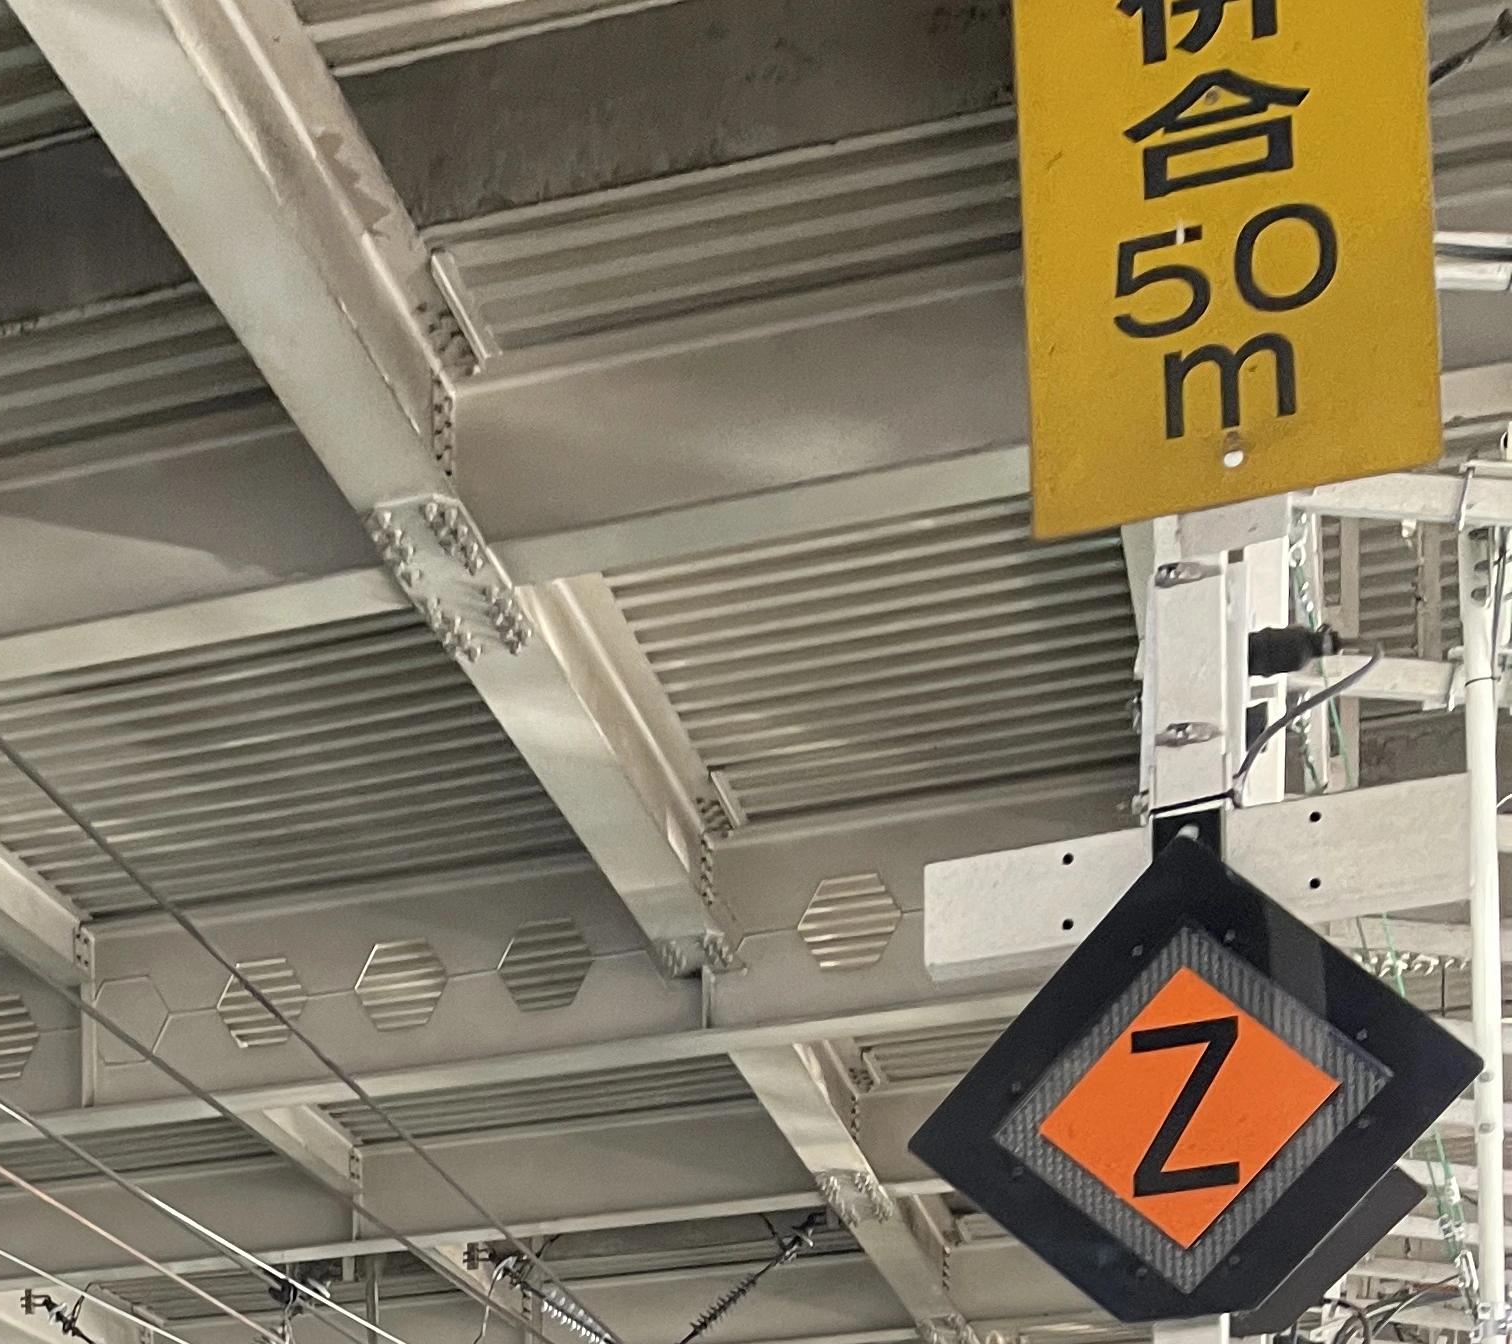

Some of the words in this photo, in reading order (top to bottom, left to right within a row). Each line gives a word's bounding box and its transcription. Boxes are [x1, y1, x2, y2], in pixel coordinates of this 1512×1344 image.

[1113, 203, 1339, 338] 50
[1162, 331, 1298, 440] m
[1129, 1014, 1240, 1198] Z
